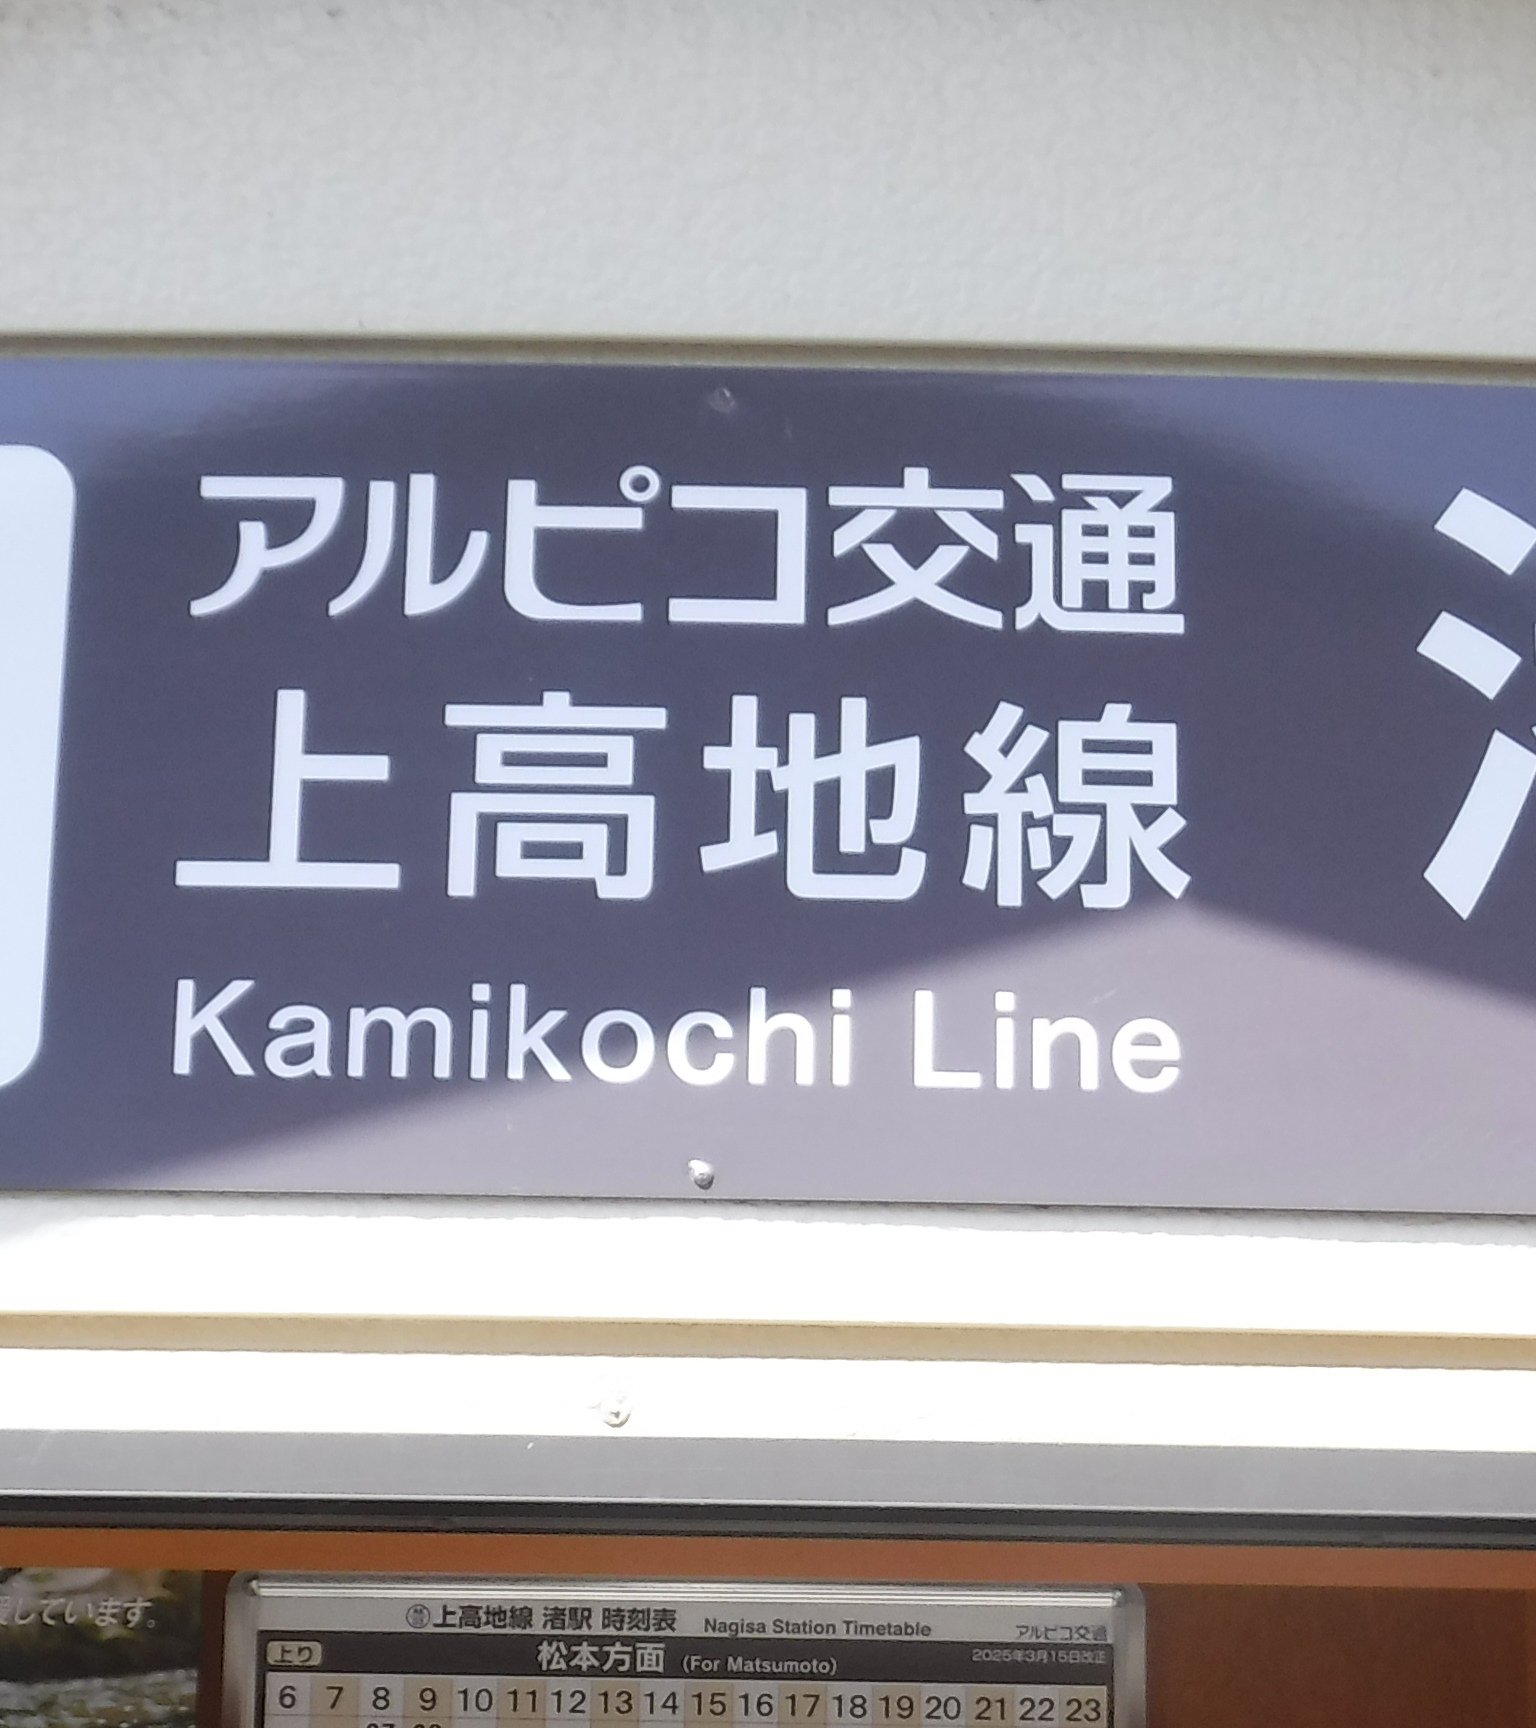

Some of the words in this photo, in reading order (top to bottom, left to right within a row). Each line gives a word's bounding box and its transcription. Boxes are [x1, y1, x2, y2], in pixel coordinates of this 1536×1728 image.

[190, 465, 1185, 634] アルピコ交通
[174, 689, 1191, 909] 上高地線
[173, 979, 852, 1087] Kamikochi
[913, 989, 1182, 1094] Line
[433, 1604, 533, 1629] 上高地線
[542, 1606, 593, 1631] 渚駅
[602, 1607, 677, 1632] 時刻表
[704, 1618, 766, 1636] Nagisa
[772, 1619, 836, 1636] Station
[842, 1620, 932, 1637] Timetable
[273, 1646, 314, 1664] 上り
[537, 1639, 665, 1672] 松本方面
[682, 1655, 724, 1675] (For
[727, 1656, 838, 1677] Matsumoto)
[278, 1685, 297, 1709] 6
[326, 1685, 344, 1710] 7
[372, 1686, 390, 1711] 8
[419, 1687, 437, 1712] 9
[457, 1687, 493, 1712] 10
[507, 1688, 537, 1713] 11
[551, 1689, 587, 1714] 12
[598, 1690, 633, 1715] 13
[643, 1691, 679, 1716] 14
[691, 1691, 727, 1717] 15
[738, 1692, 774, 1717] 16
[785, 1693, 821, 1718] 17
[832, 1694, 868, 1719] 18
[878, 1695, 914, 1720] 19
[924, 1695, 962, 1721] 20
[974, 1696, 1006, 1721] 21
[1019, 1697, 1055, 1722] 22
[1065, 1697, 1101, 1722] 23
